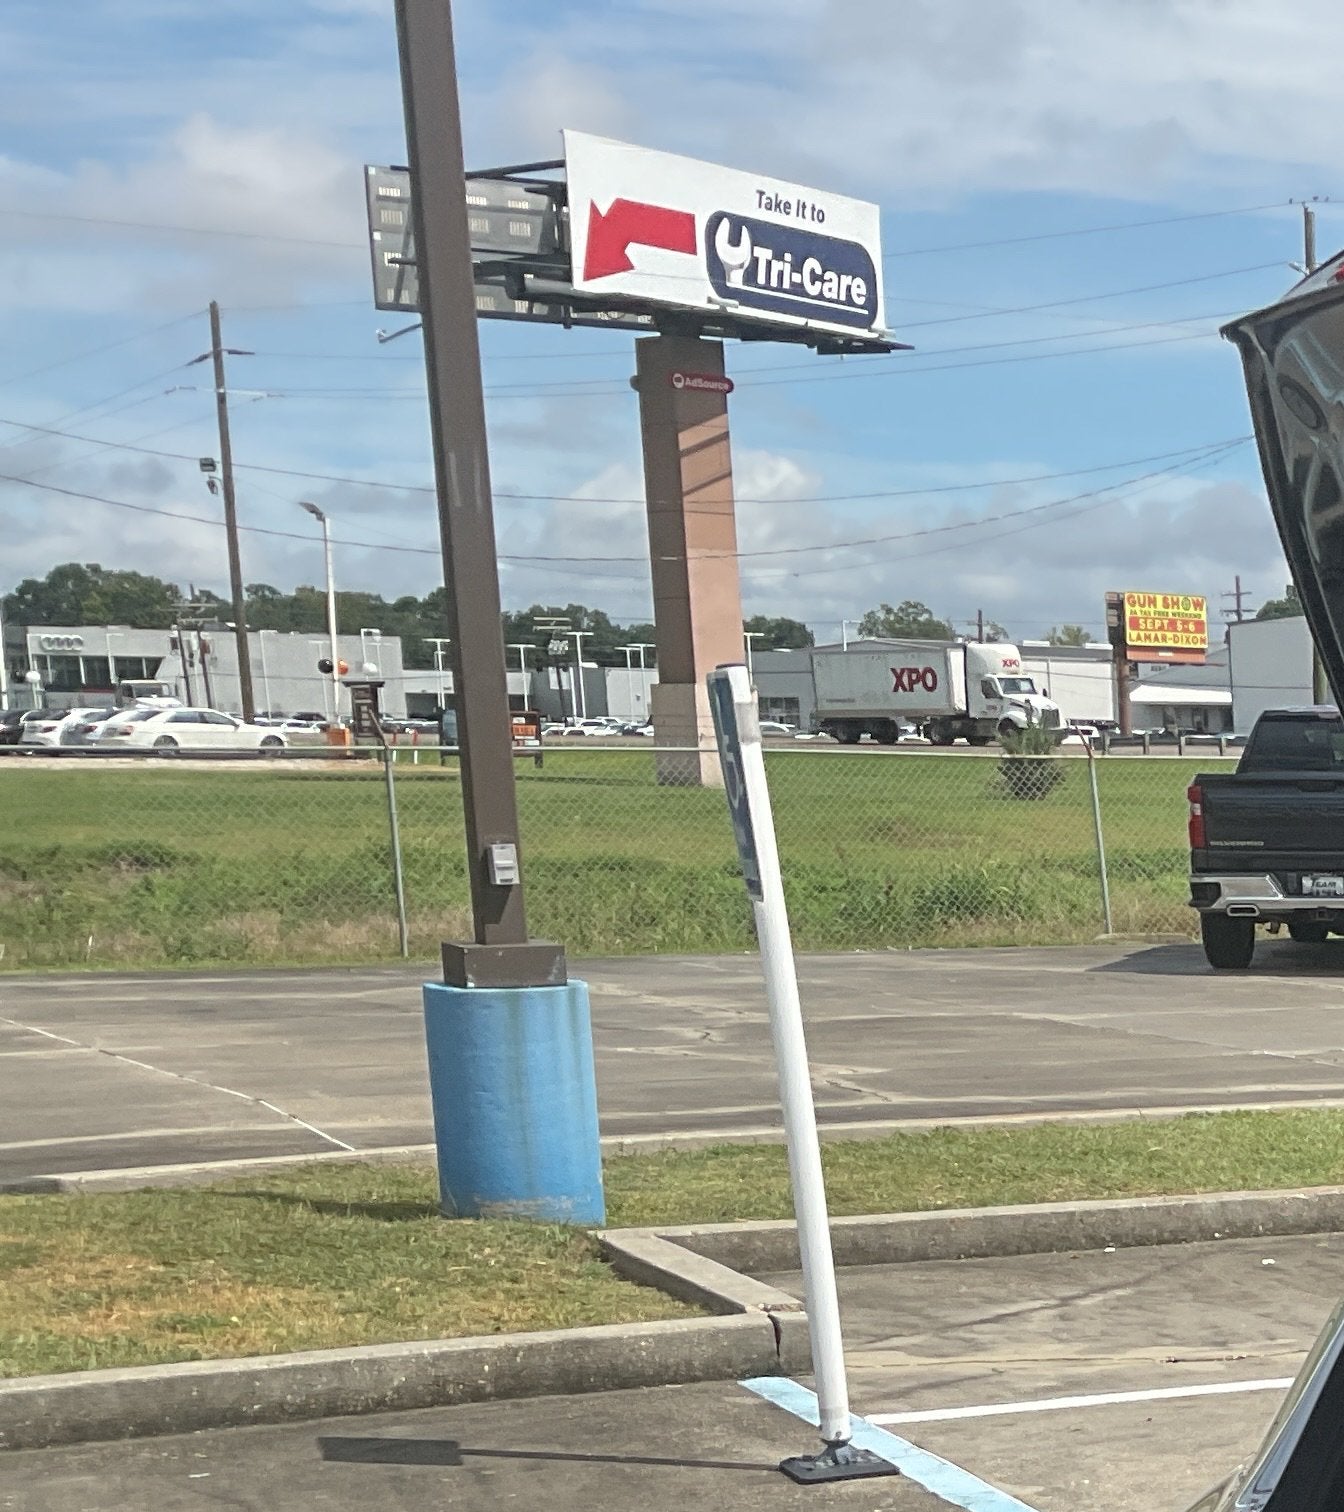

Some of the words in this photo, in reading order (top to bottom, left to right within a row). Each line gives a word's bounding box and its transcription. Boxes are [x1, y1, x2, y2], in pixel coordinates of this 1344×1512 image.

[756, 190, 792, 216] Take
[796, 199, 807, 219] It
[811, 204, 825, 224] to
[753, 246, 867, 306] Tri-Care
[1127, 594, 1157, 608] GUN
[1162, 596, 1204, 611] SHOW
[1176, 621, 1195, 631] 5-6
[1129, 632, 1207, 645] LAMAR-DIXON
[1002, 658, 1020, 668] XPO
[890, 666, 938, 693] XPO
